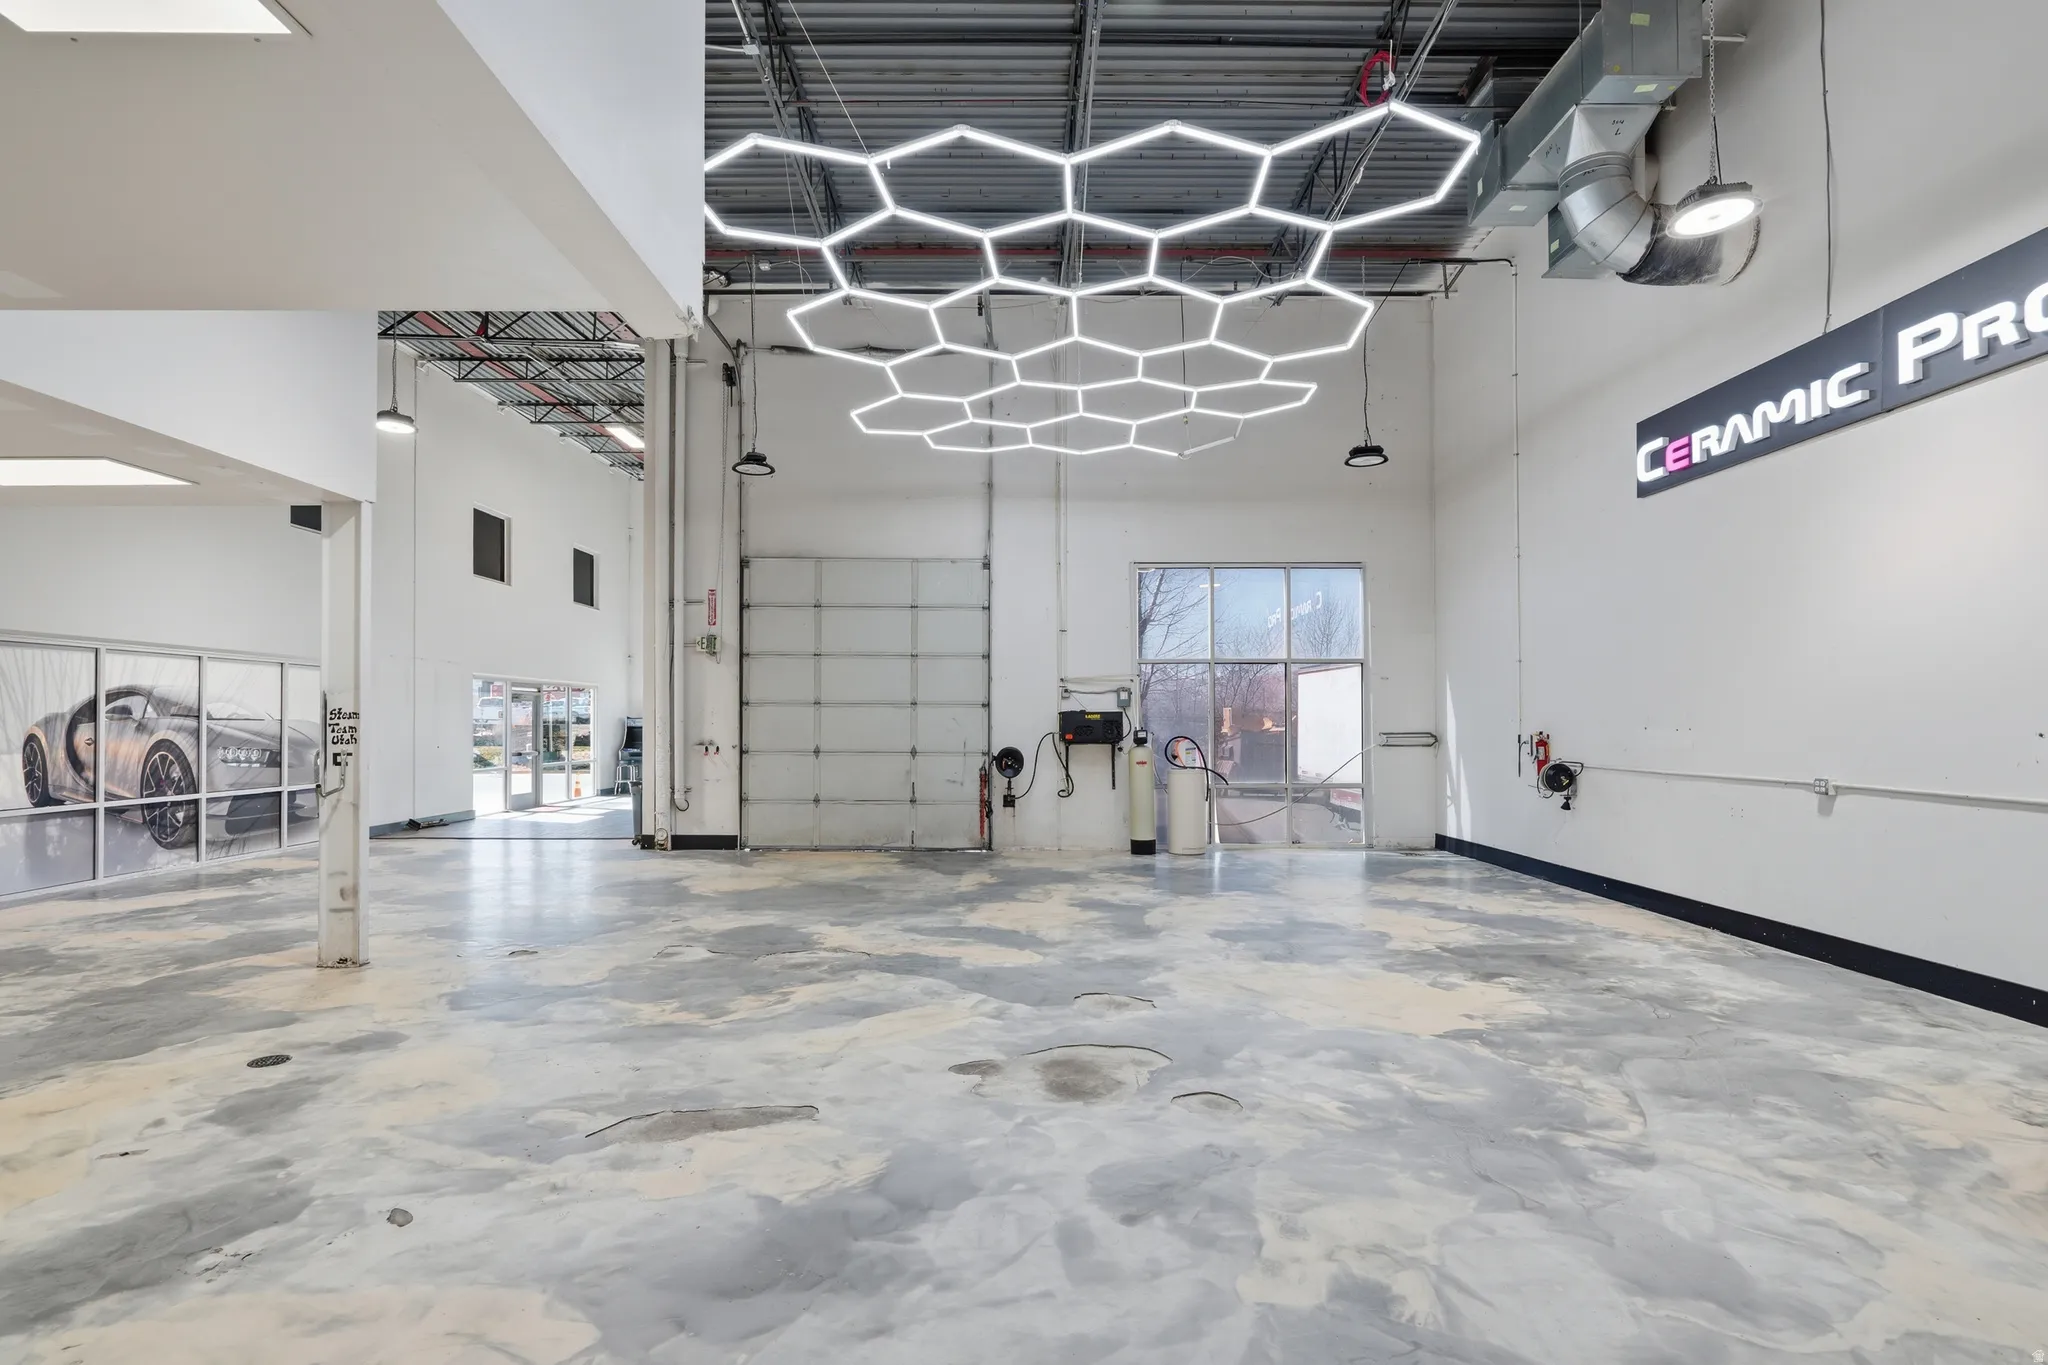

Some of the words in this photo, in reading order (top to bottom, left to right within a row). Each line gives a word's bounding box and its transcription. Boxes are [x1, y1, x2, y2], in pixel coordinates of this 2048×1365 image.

[1636, 361, 1870, 483] CERAMIC
[329, 707, 359, 720] Steam
[328, 723, 357, 733] Team
[331, 734, 357, 745] Utah
